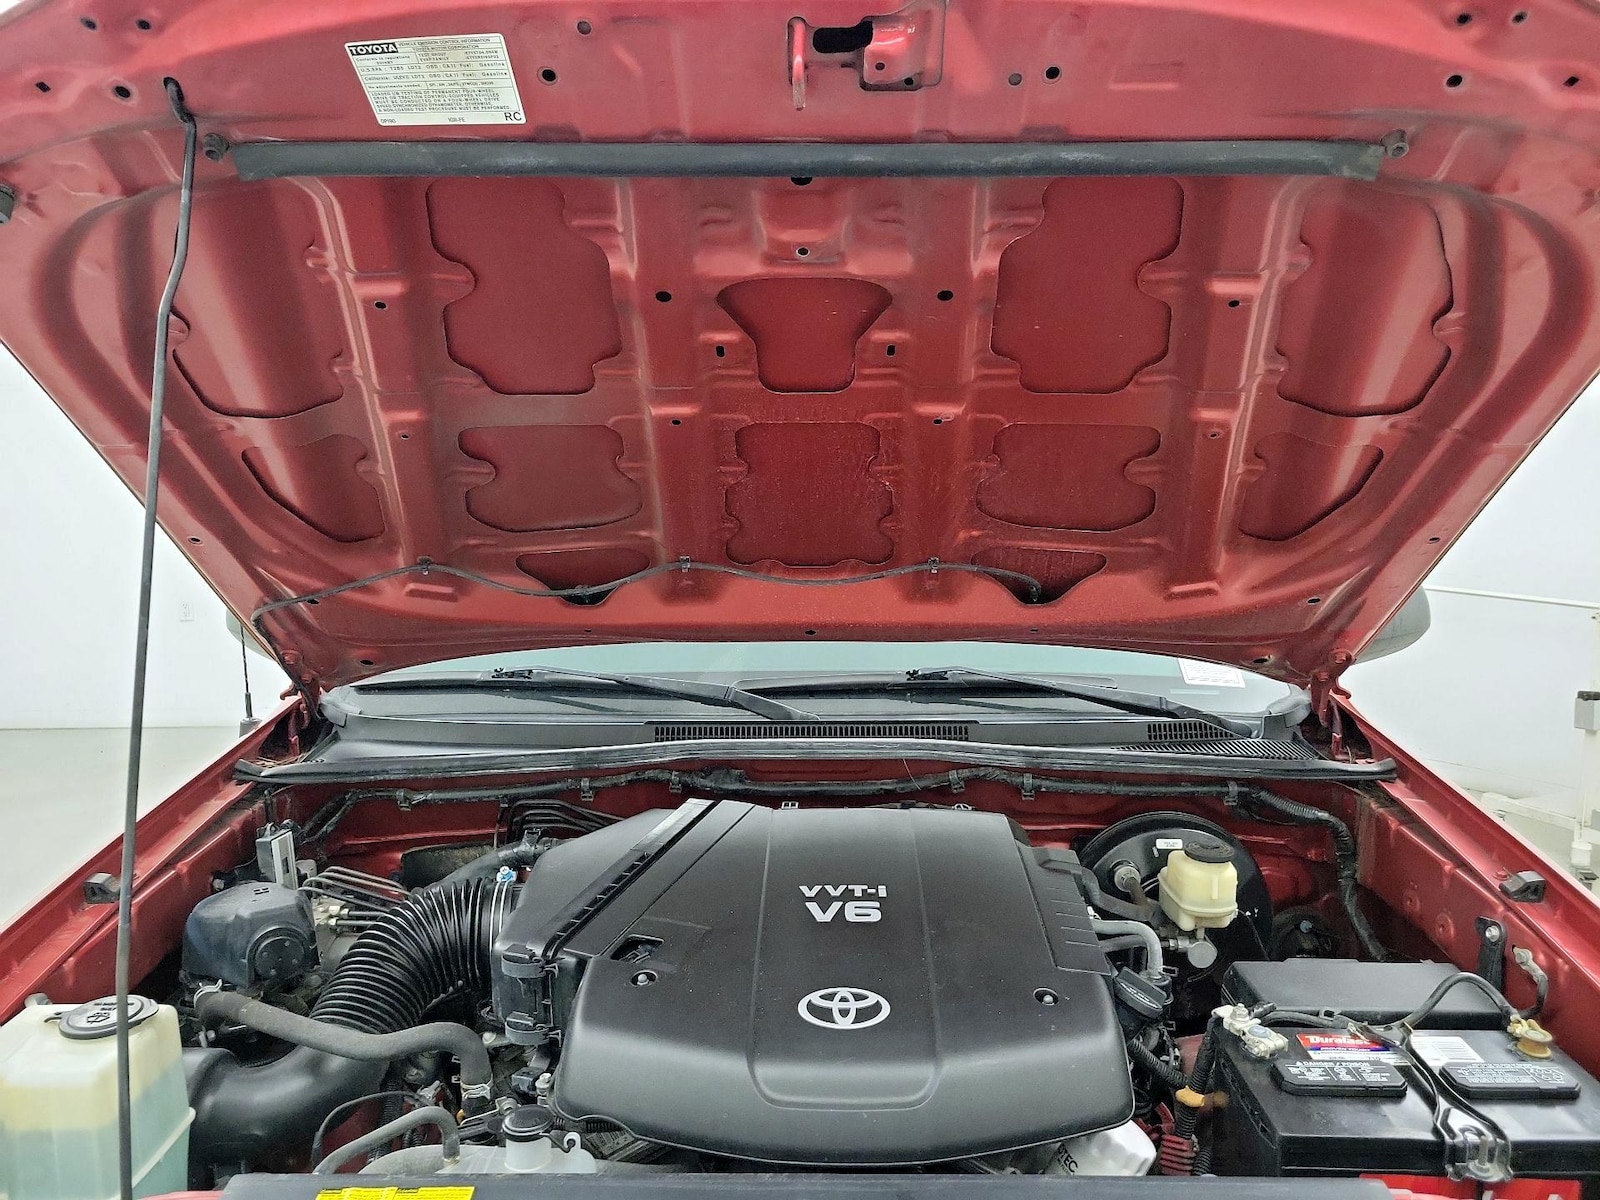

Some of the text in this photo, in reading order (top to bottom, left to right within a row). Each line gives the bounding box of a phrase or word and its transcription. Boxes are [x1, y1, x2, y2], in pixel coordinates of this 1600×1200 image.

[350, 44, 397, 55] TOYOTA
[504, 112, 522, 121] RC
[799, 884, 888, 898] VVT-i
[804, 901, 882, 923] V6
